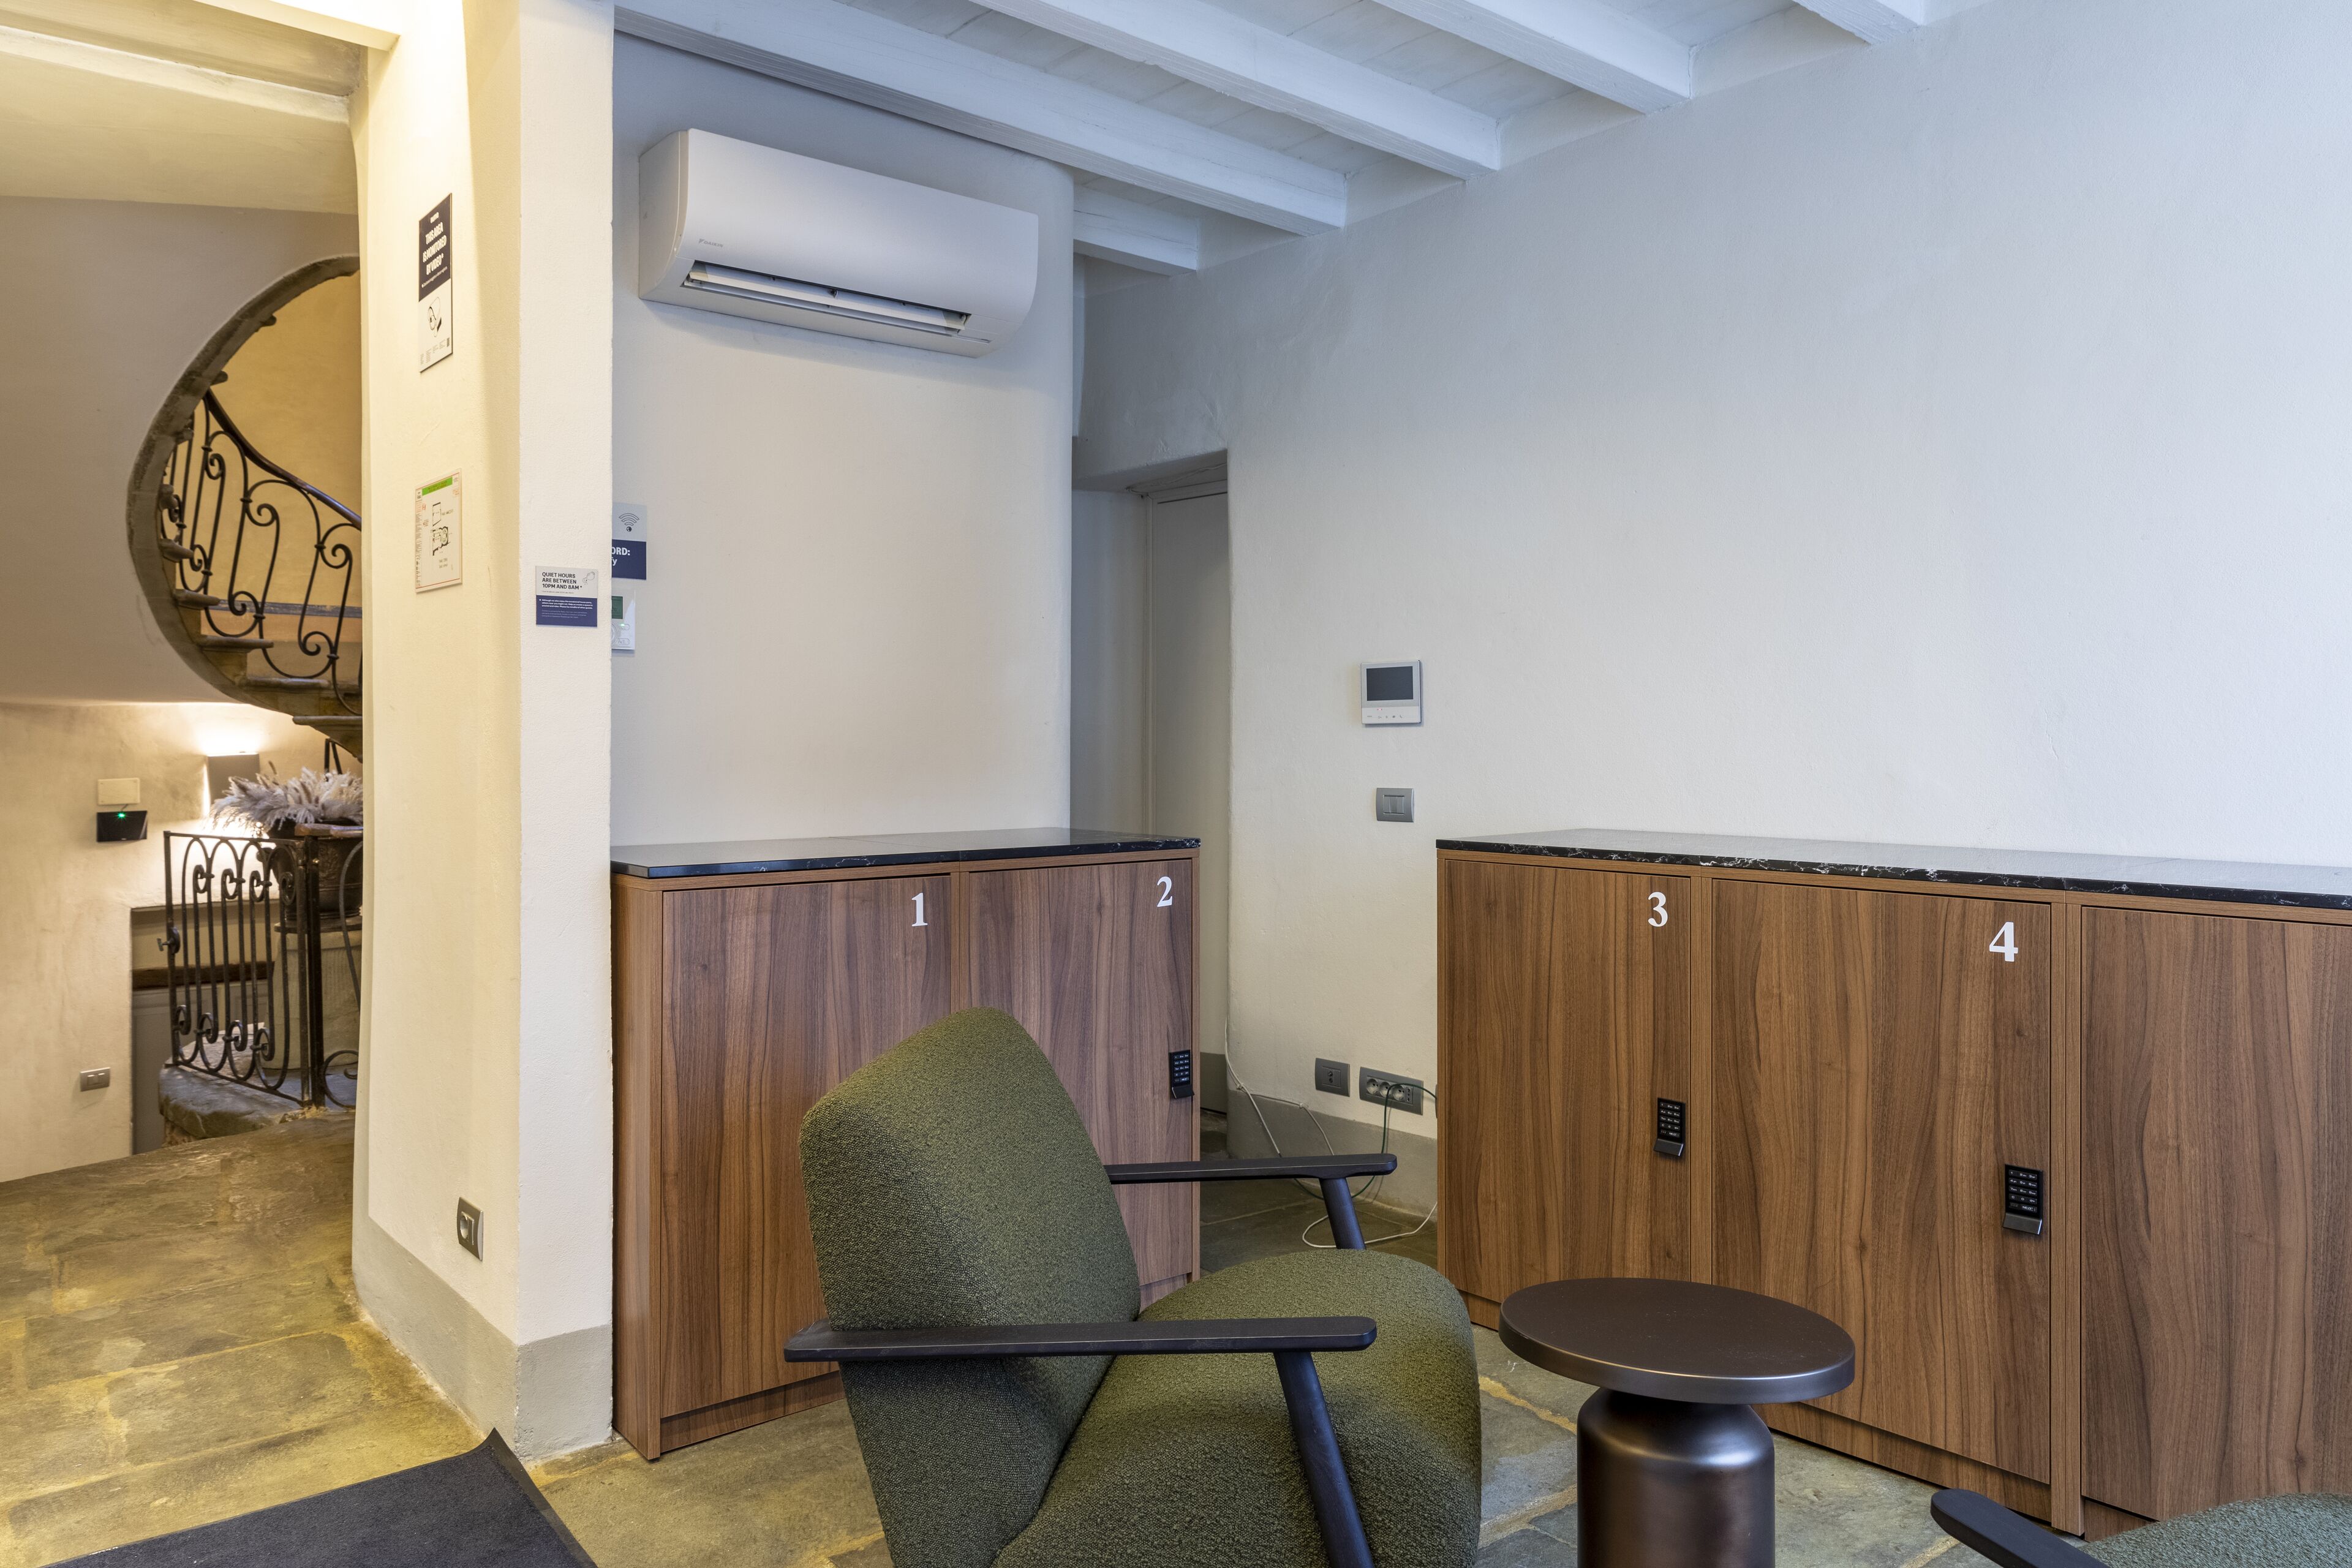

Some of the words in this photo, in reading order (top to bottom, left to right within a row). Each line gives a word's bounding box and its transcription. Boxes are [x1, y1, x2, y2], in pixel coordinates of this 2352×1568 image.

[434, 222, 443, 238] AREA
[426, 235, 447, 260] MONITORED
[426, 263, 431, 275] BY
[1156, 876, 1172, 908] 2
[911, 892, 928, 927] 1
[1648, 891, 1668, 927] 3
[1989, 921, 2019, 962] 4
